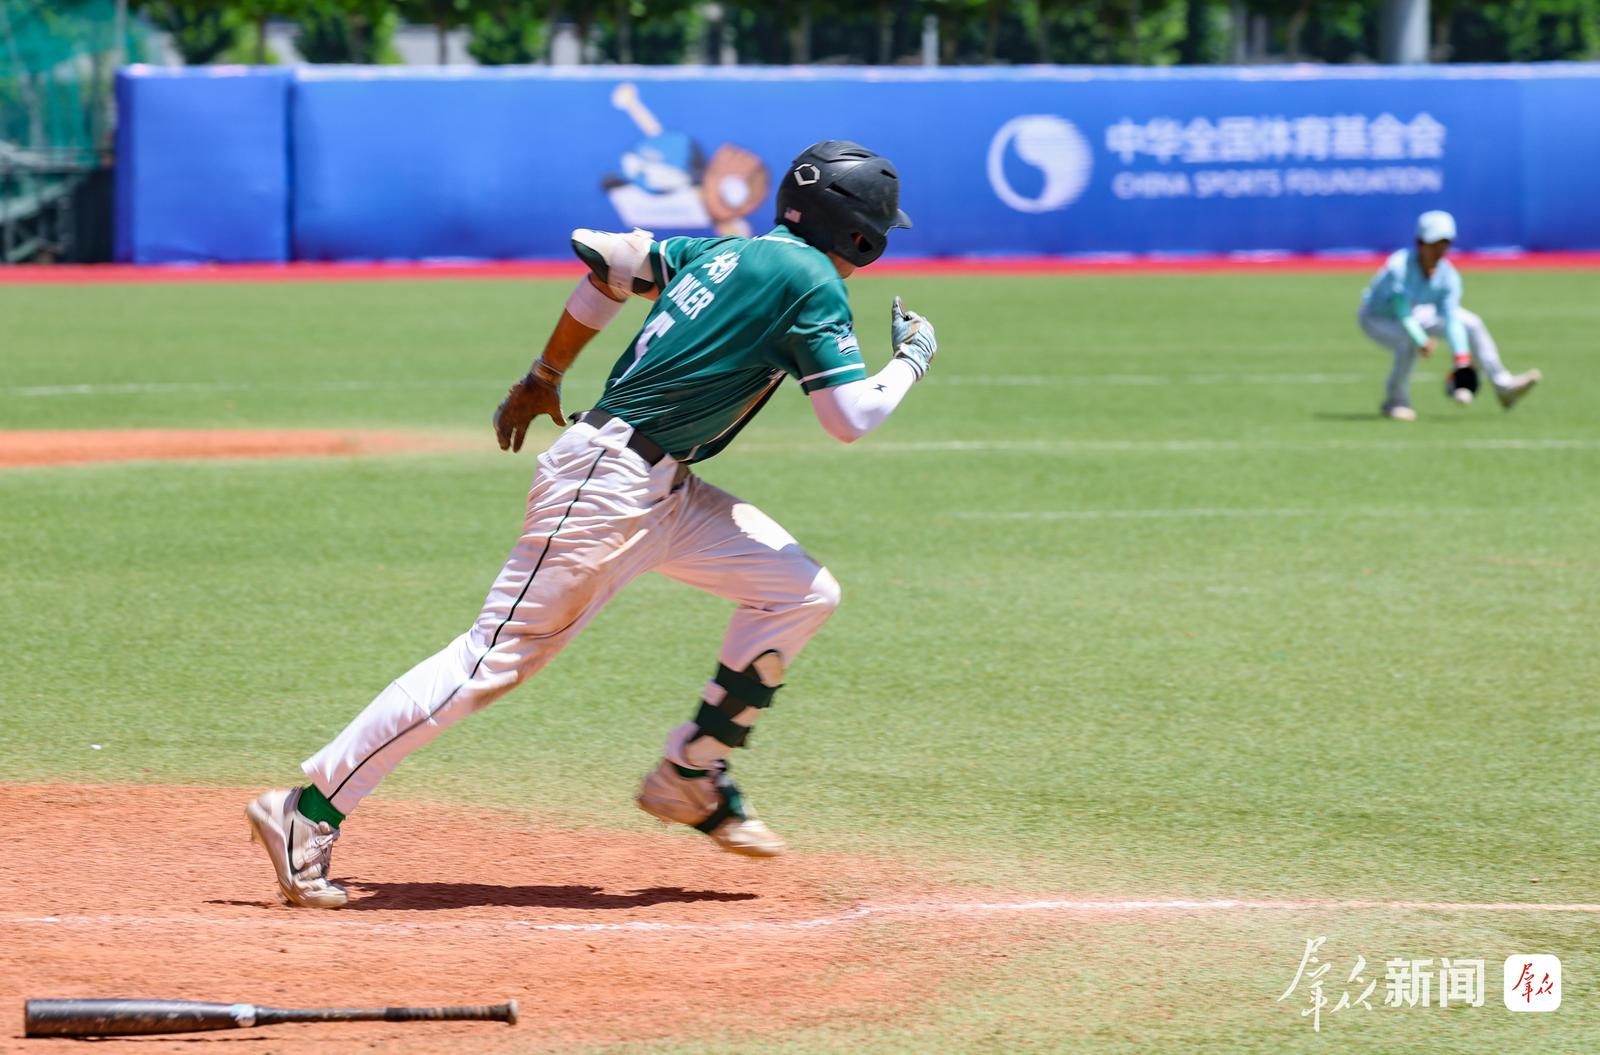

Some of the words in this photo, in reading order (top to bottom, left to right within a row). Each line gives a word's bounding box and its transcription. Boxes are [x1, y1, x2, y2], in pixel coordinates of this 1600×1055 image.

[1107, 112, 1447, 163] 中华全国体育基金会
[1112, 170, 1189, 199] CHINA
[1195, 169, 1282, 198] SPORTS
[1285, 166, 1442, 196] FOUNDATION
